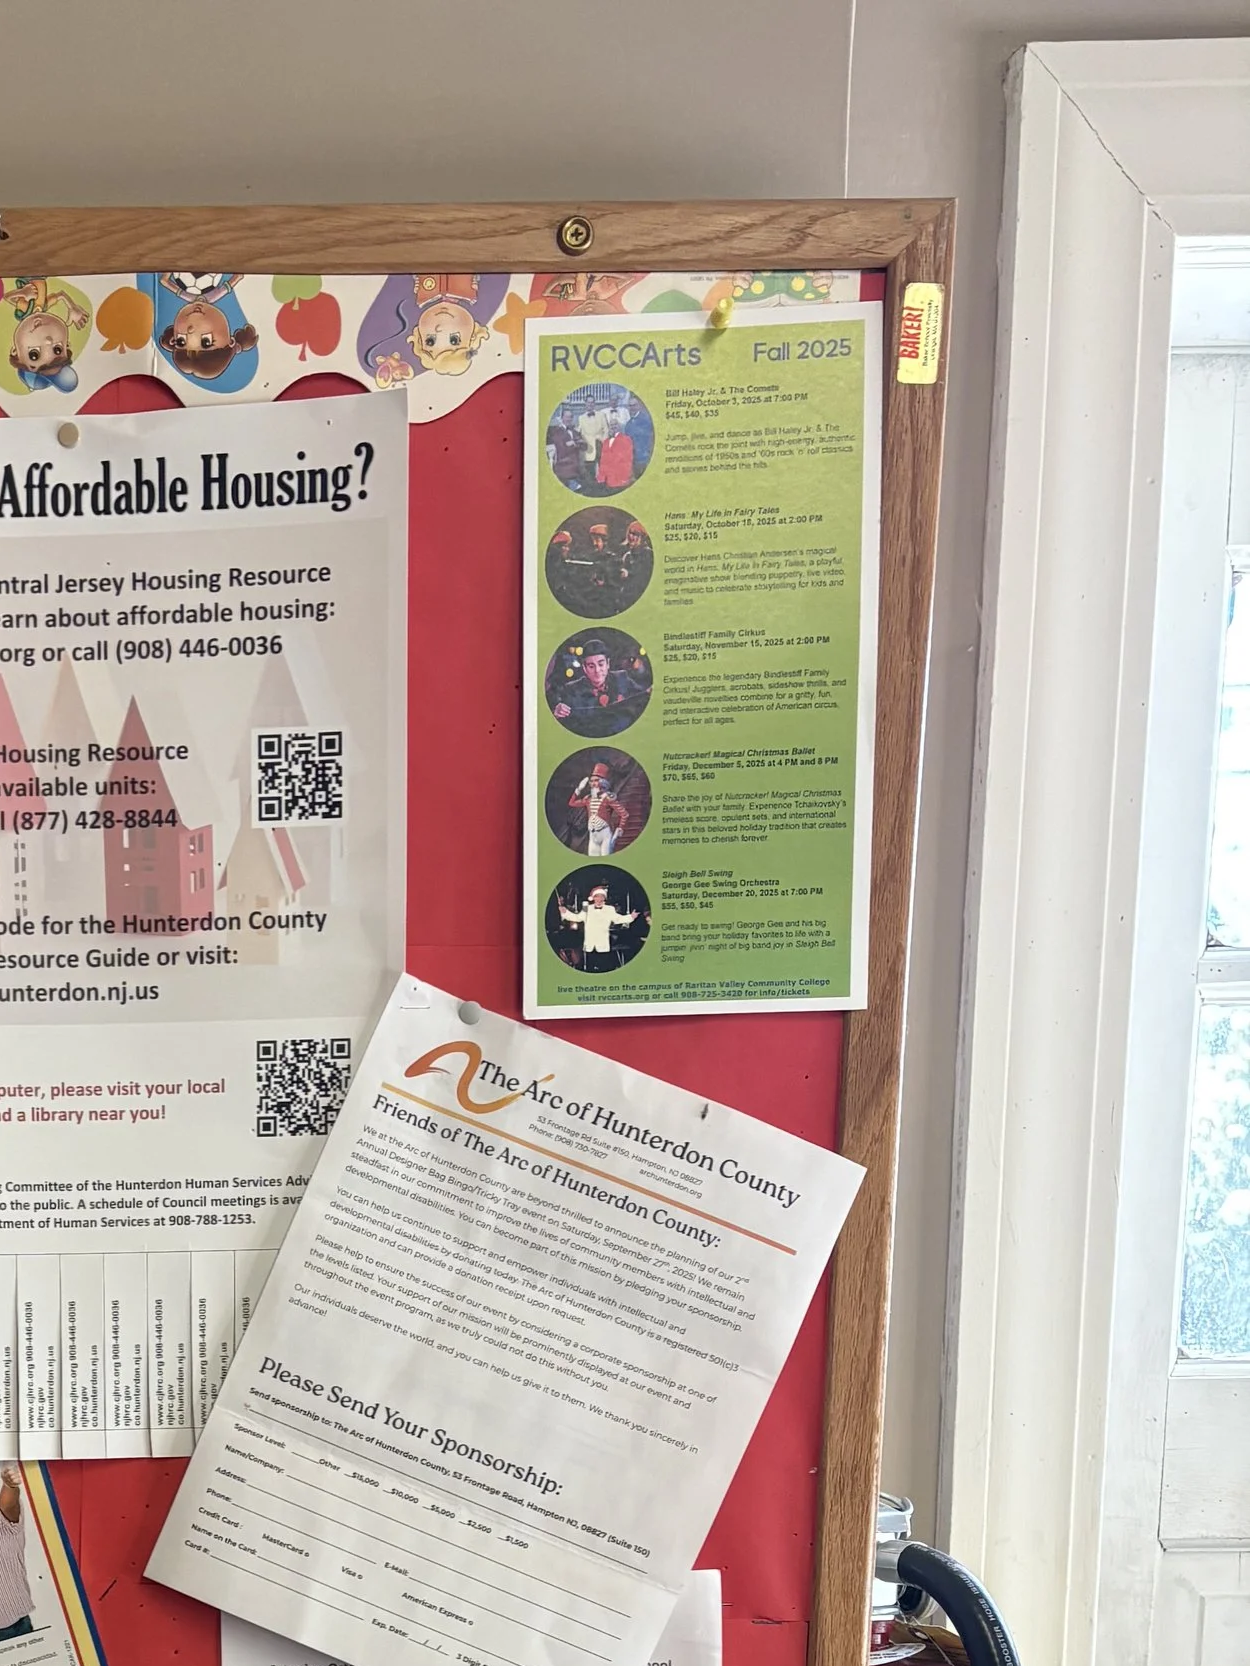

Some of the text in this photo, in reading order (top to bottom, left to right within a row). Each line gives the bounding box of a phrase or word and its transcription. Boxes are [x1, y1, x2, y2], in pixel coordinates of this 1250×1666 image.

[551, 341, 702, 372] RVCCArts
[753, 338, 852, 363] Fall 2025
[200, 441, 375, 513] Housing?
[54, 574, 125, 597] Jersey
[131, 569, 222, 593] Housing
[229, 566, 331, 587] Resource
[42, 647, 66, 662] or
[72, 640, 108, 661] call
[116, 637, 172, 665] (908)
[178, 634, 283, 658] 446-0036
[479, 1059, 801, 1209] The Arc of Hunterdon County
[37, 1217, 51, 1229] of
[53, 1217, 98, 1229] Human
[100, 1215, 150, 1228] Services
[153, 1216, 166, 1227] at
[168, 1213, 256, 1226] 908-788-1253.
[258, 1356, 563, 1496] Please Send Your Sponsorship:
